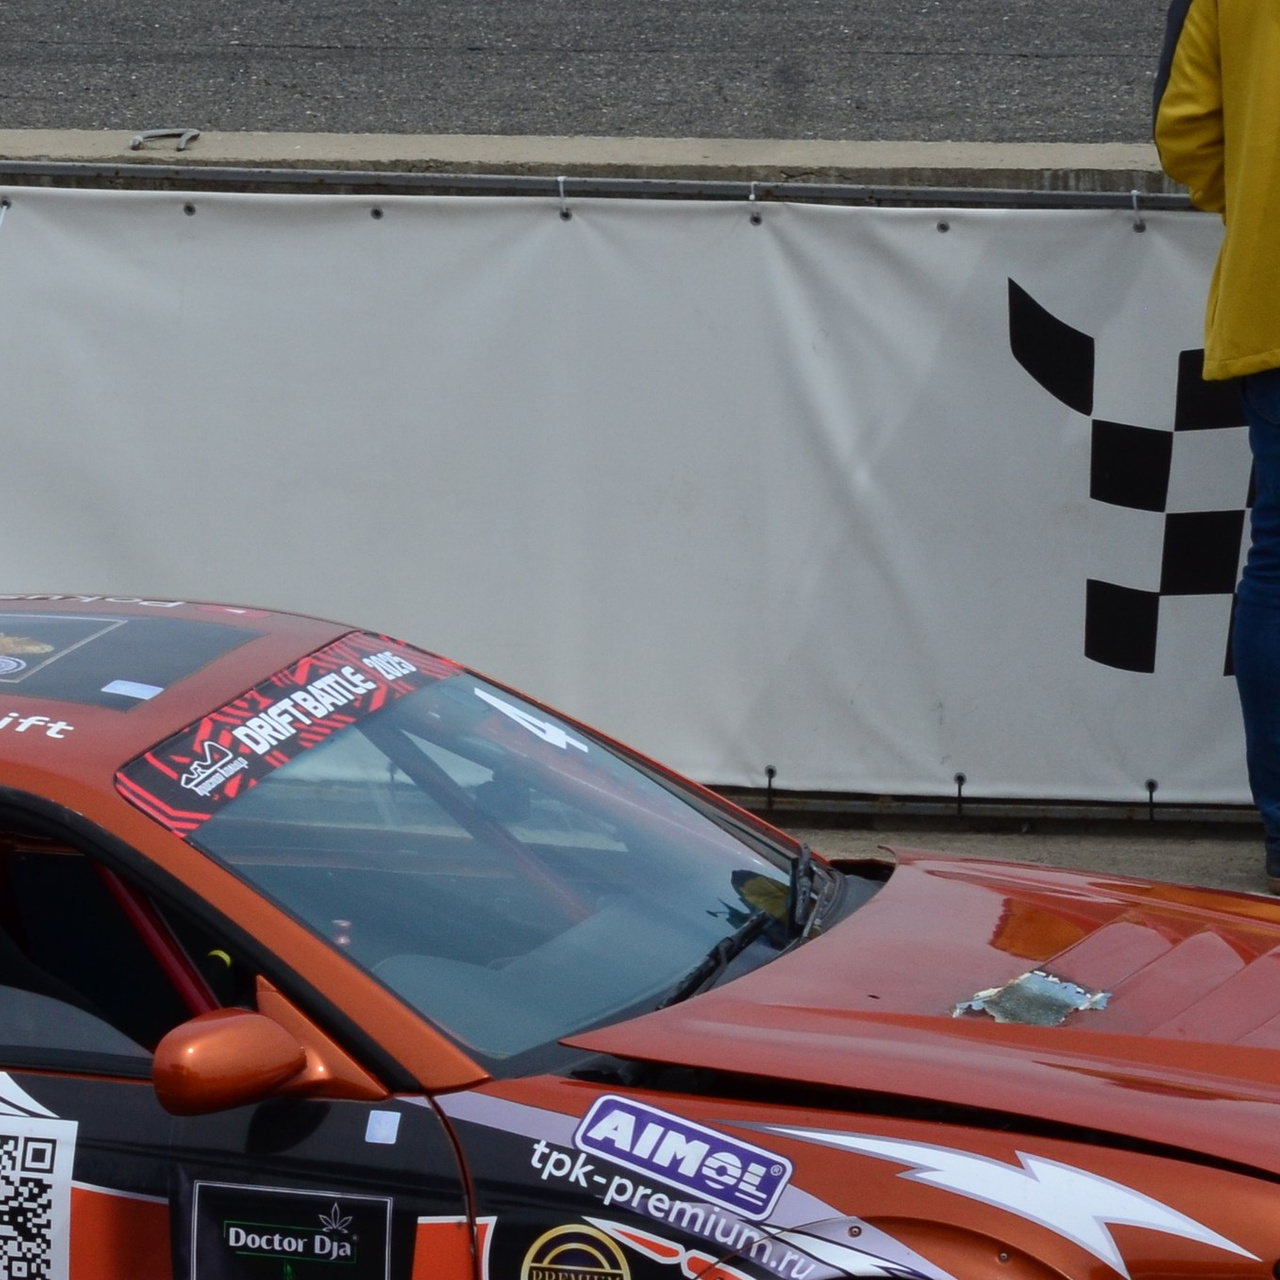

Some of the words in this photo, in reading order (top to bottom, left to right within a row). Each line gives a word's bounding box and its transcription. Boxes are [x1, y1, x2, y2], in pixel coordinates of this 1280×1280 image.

[232, 698, 312, 755] DRIFT
[291, 666, 377, 719] BATTLE
[362, 651, 417, 680] 2025
[587, 1109, 767, 1206] AIMOL
[229, 1227, 308, 1253] Doctor
[314, 1234, 351, 1260] Dja
